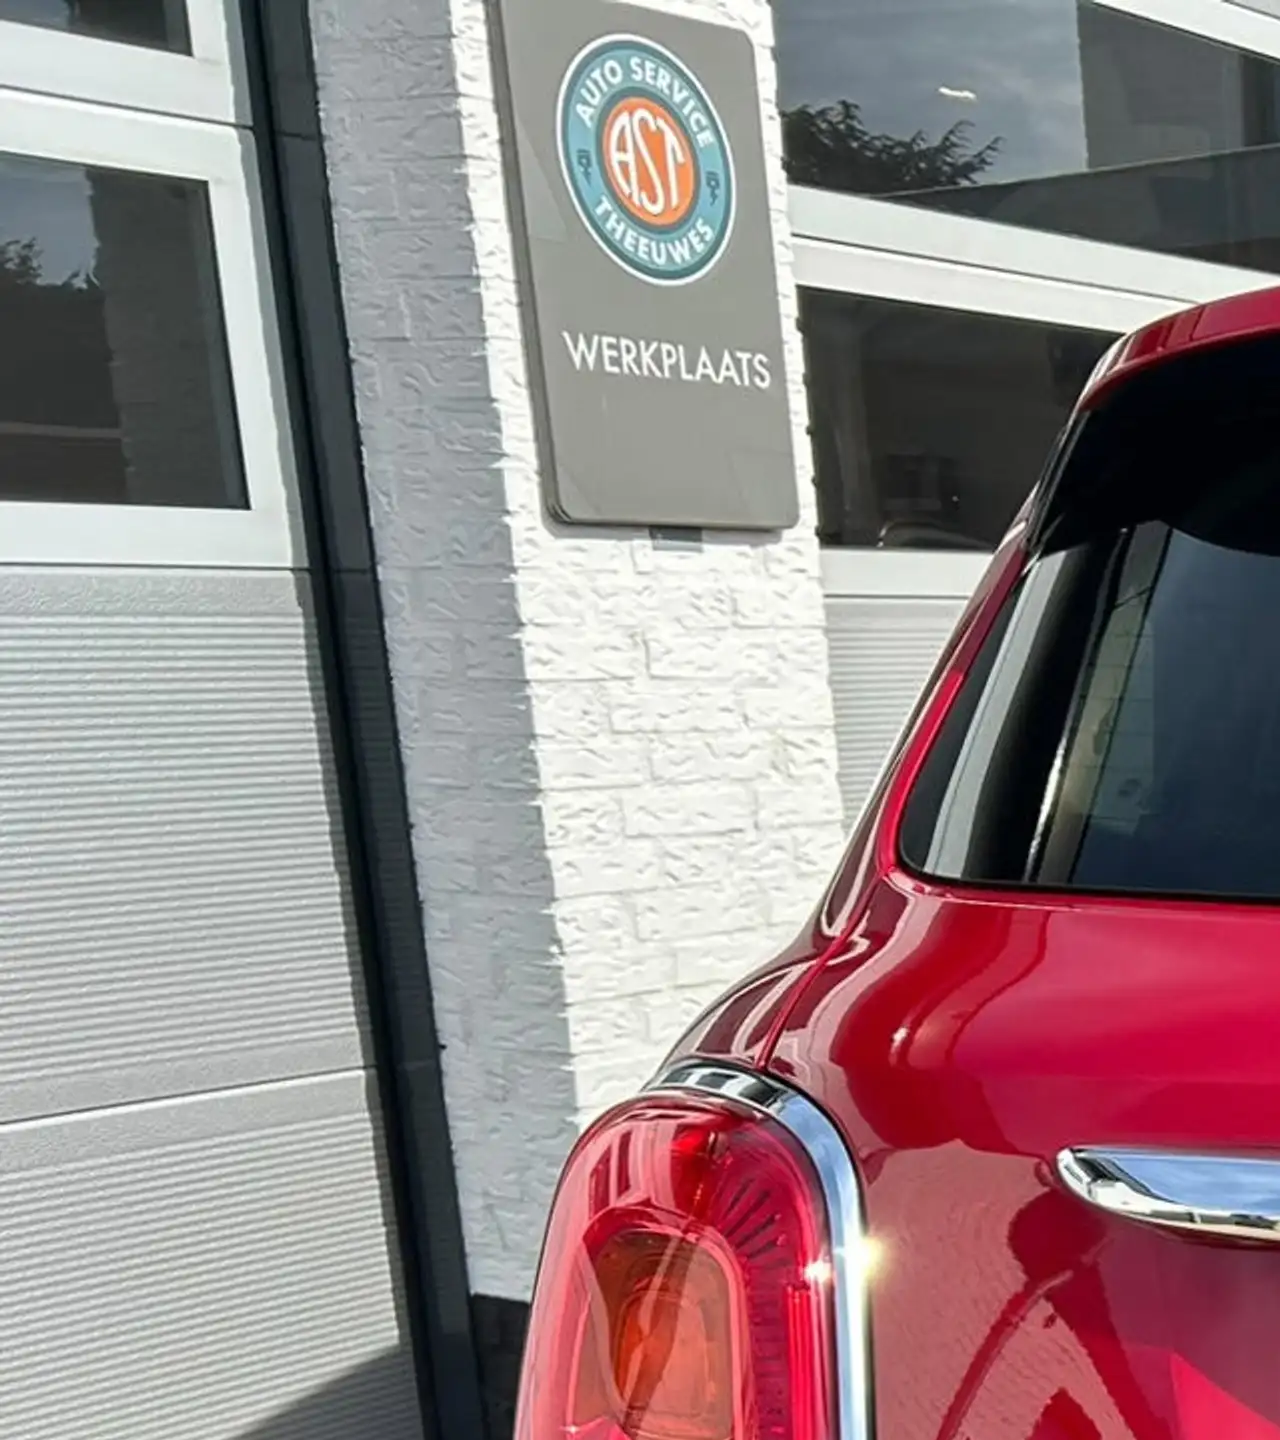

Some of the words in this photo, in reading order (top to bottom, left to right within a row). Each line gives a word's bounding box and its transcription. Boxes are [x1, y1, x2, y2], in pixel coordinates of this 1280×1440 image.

[574, 57, 623, 128] AUTO
[630, 56, 716, 148] SERVICE
[608, 108, 686, 215] AST
[594, 200, 714, 266] THEEUWES
[562, 331, 772, 389] WERKPLAATS
